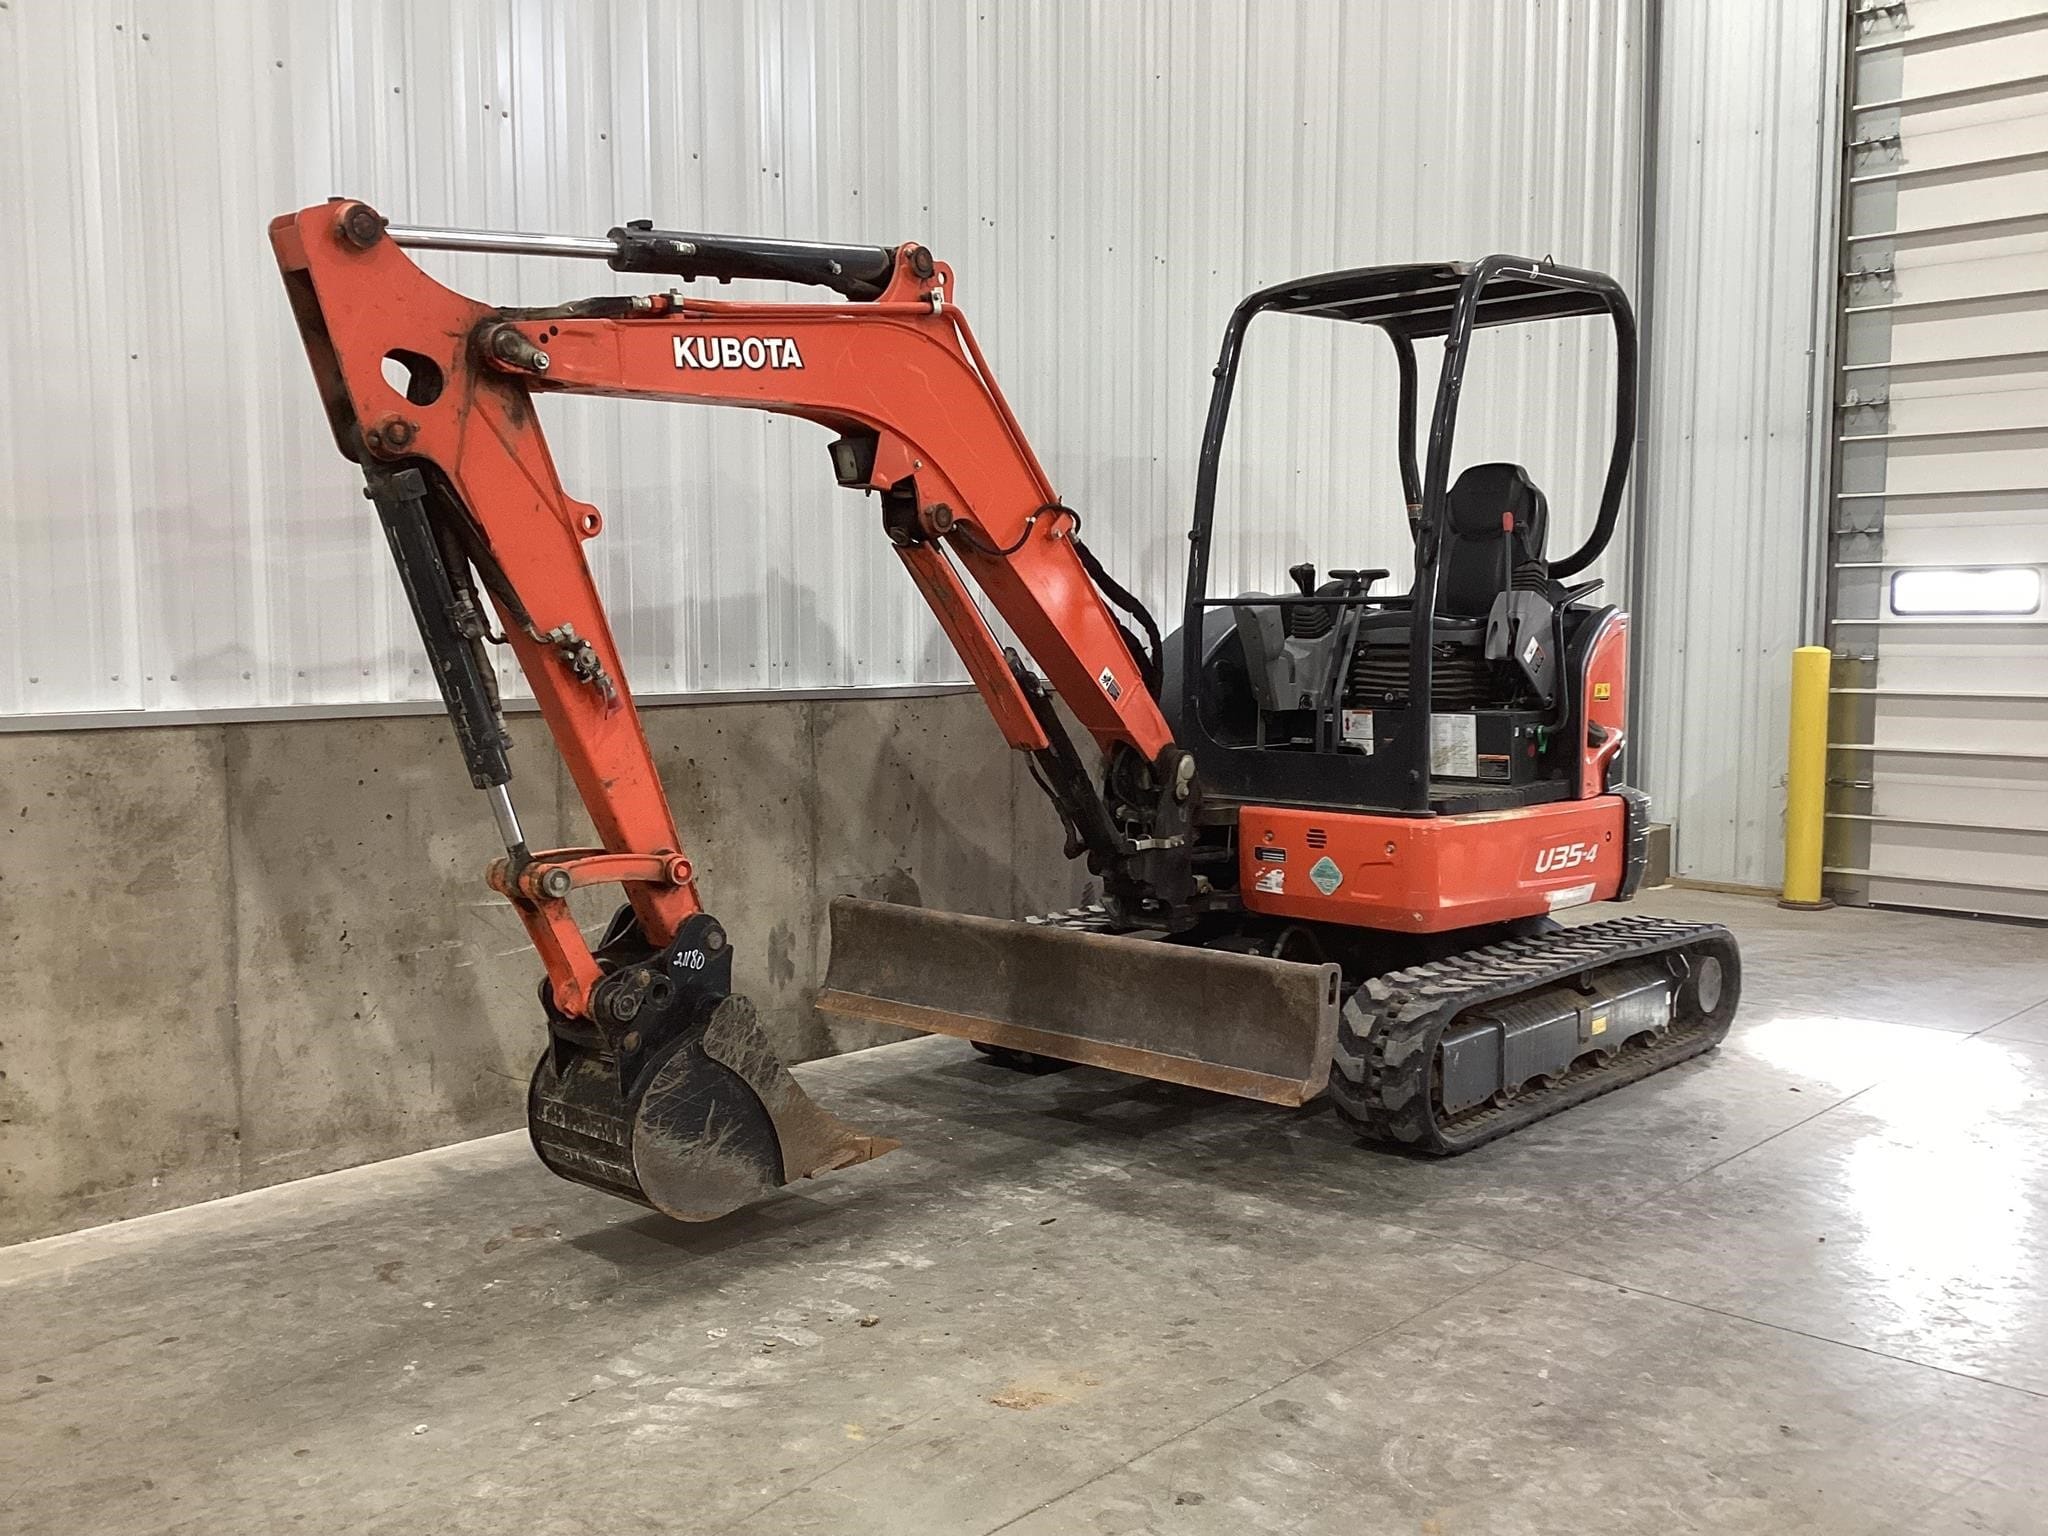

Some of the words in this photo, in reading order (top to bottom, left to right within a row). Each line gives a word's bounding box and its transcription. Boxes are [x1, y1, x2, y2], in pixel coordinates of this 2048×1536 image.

[672, 336, 804, 369] KUBOTA
[1535, 842, 1599, 873] U35-4
[673, 949, 705, 970] 21180
